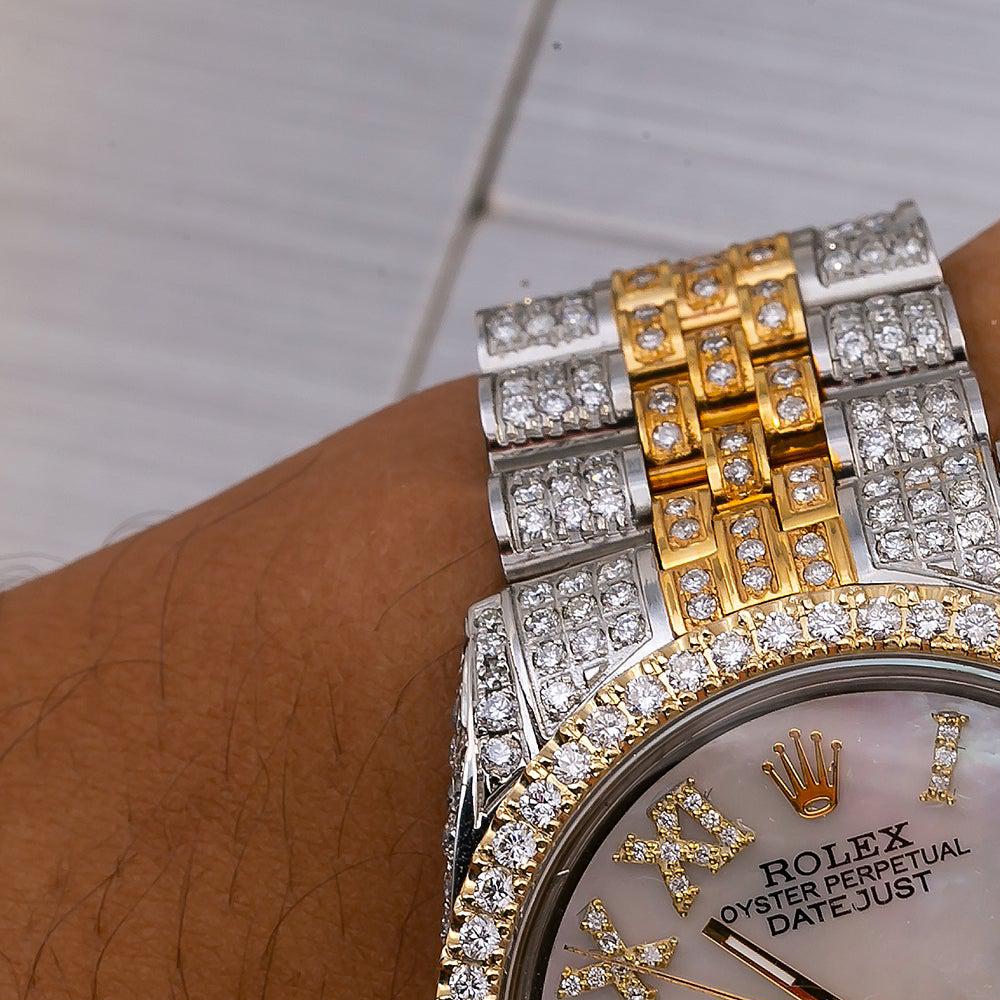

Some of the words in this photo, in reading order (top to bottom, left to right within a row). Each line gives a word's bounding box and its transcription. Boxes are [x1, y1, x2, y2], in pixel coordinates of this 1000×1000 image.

[919, 711, 970, 805] I
[612, 777, 755, 917] XI
[720, 881, 818, 924] OYSTER
[824, 838, 971, 894] PERPETUAL
[759, 821, 914, 889] ROLEX
[767, 870, 932, 937] DATEJUST
